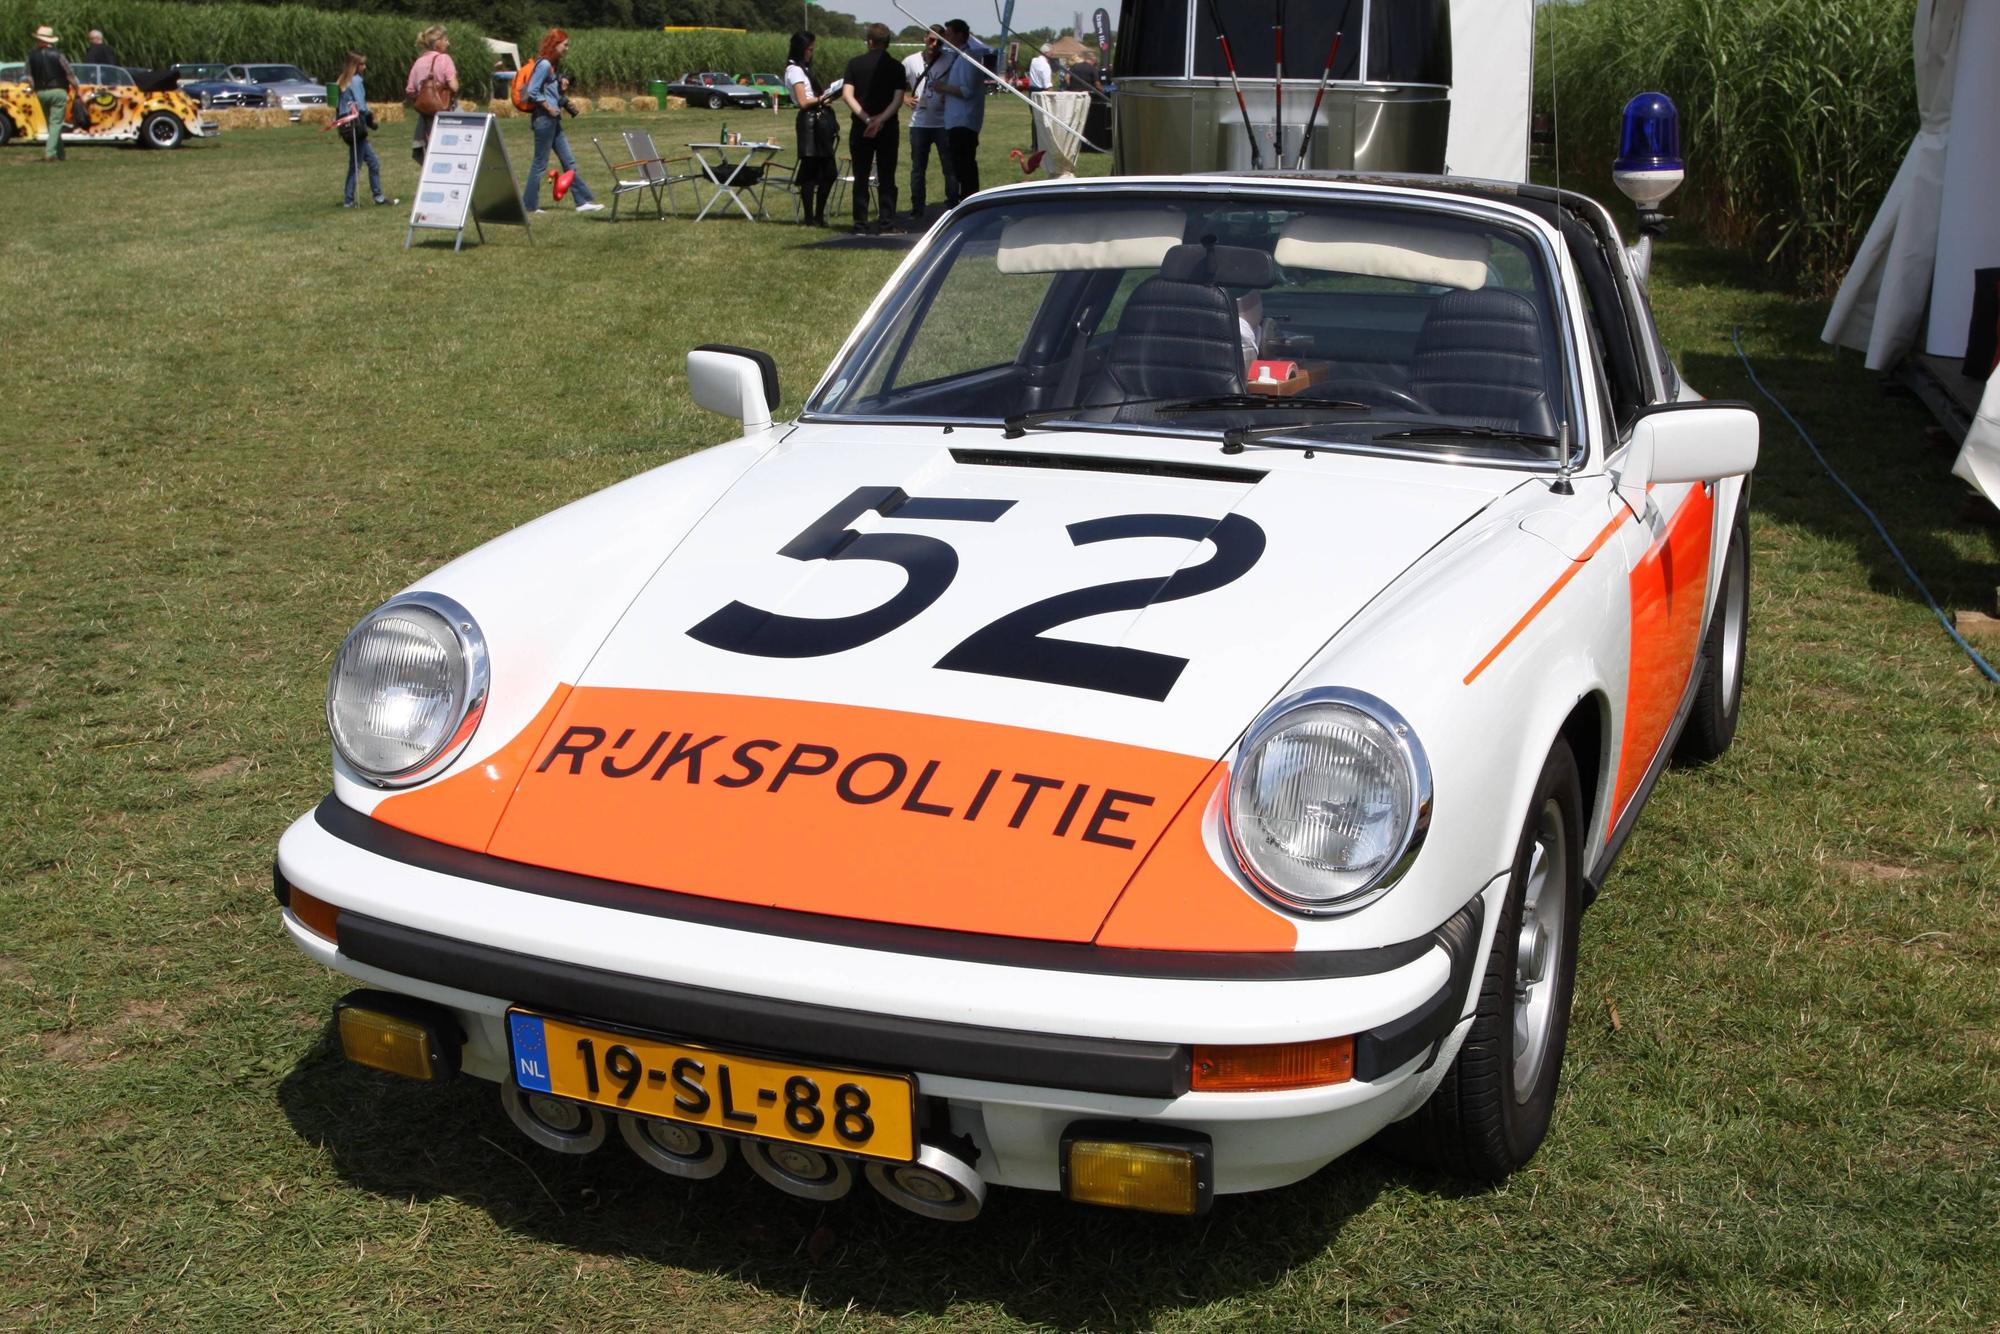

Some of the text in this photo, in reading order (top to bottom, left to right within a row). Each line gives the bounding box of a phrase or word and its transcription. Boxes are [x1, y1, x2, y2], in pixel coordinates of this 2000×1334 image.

[685, 486, 1267, 702] 52
[521, 1058, 545, 1078] NL
[577, 1038, 875, 1142] 19-SL-88
